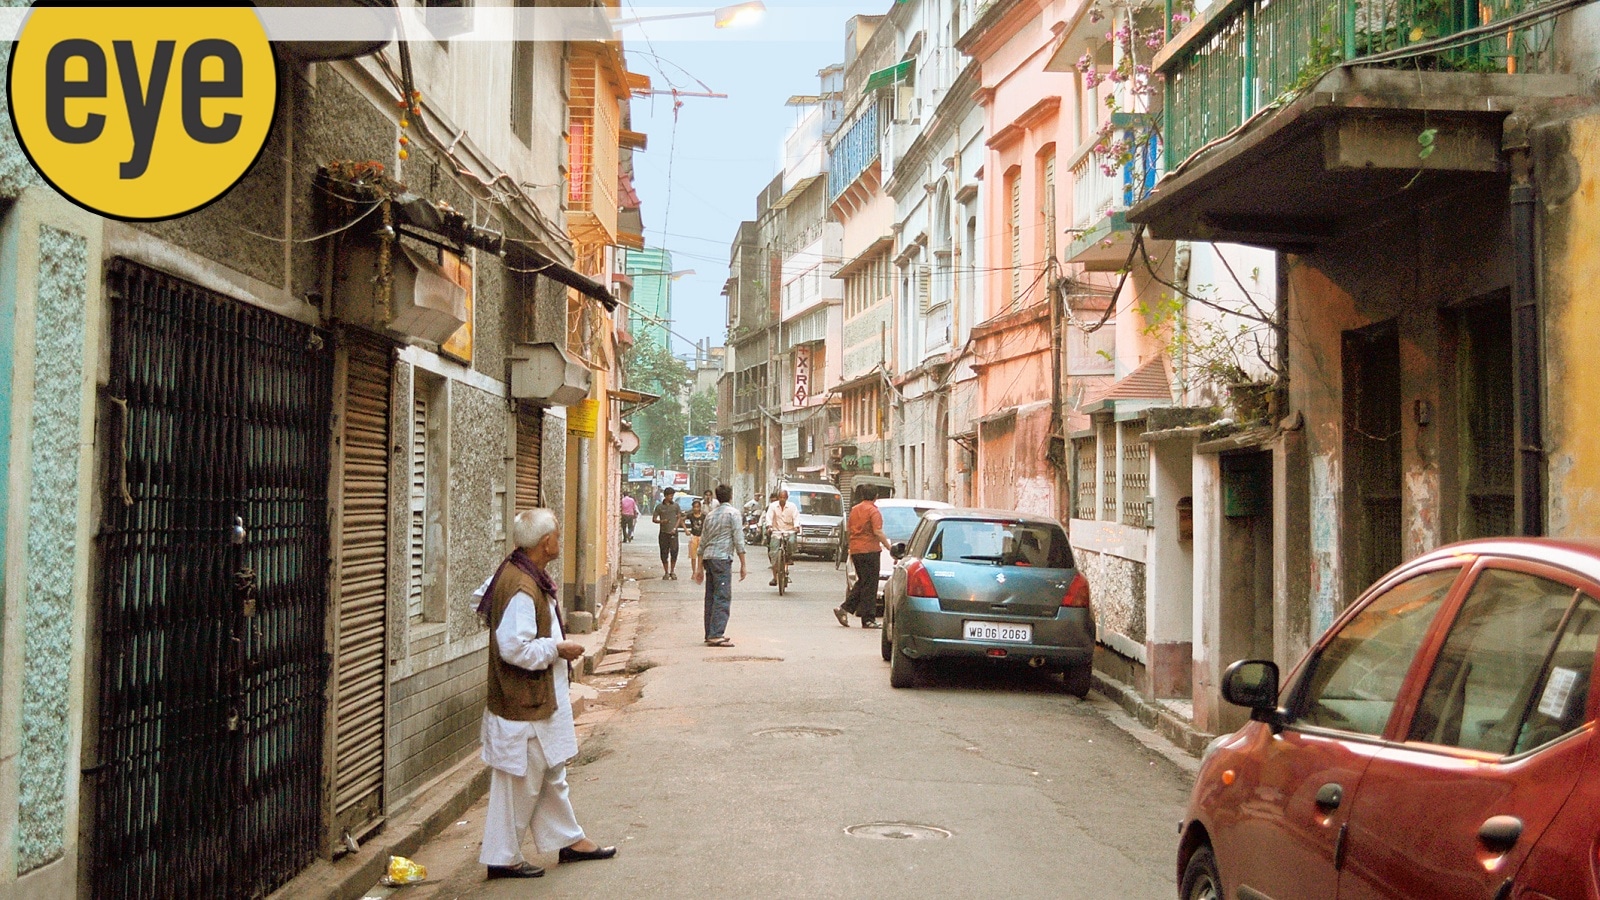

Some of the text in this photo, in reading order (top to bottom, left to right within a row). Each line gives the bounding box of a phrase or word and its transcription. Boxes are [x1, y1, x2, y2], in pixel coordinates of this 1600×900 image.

[796, 356, 809, 406] X-RAY
[969, 627, 1027, 640] WB 06 2063
